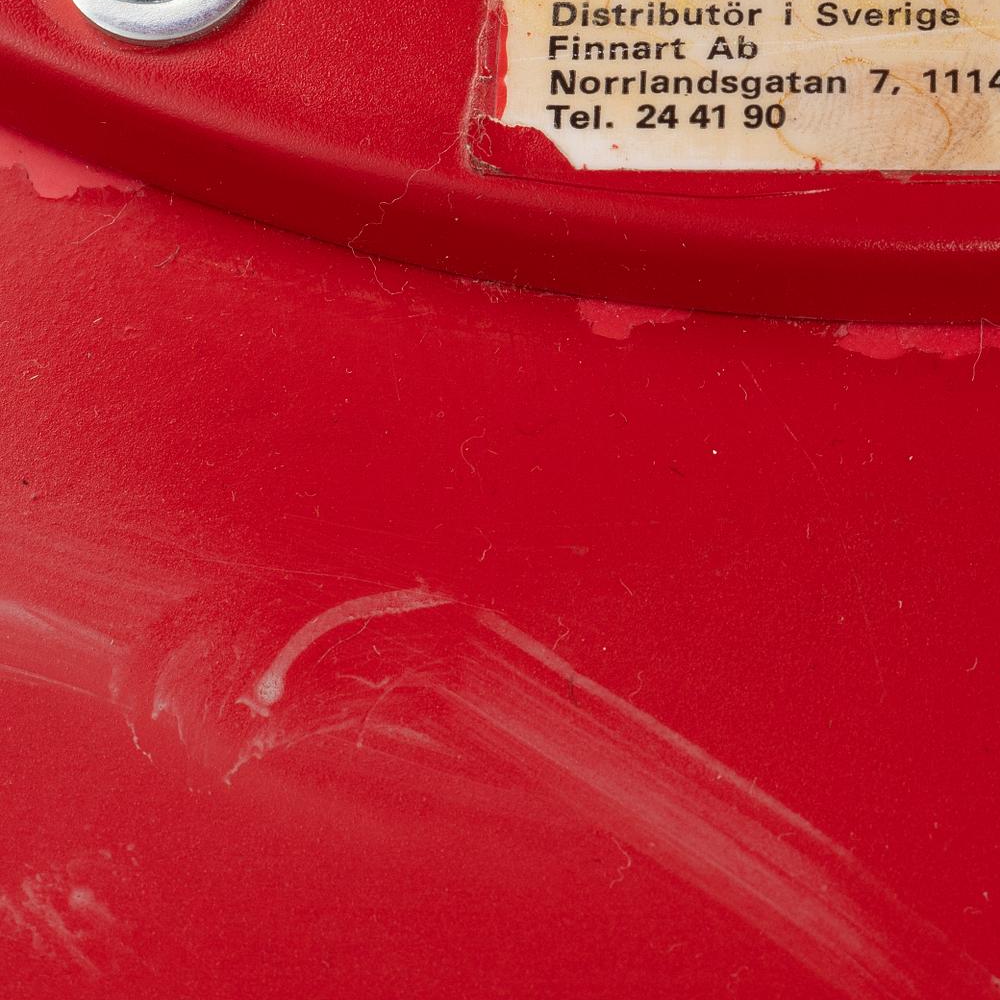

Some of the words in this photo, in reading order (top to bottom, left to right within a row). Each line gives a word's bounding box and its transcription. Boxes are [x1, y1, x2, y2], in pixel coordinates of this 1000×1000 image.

[552, 1, 762, 27] Distributör
[784, 1, 792, 26] i
[816, 1, 960, 31] Sverige
[548, 35, 686, 60] Finnart
[707, 35, 758, 60] Ab
[550, 69, 847, 100] Norrlandsgatan
[870, 69, 900, 96] 7,
[546, 104, 614, 130] Tel.
[636, 104, 679, 129] 24
[689, 104, 725, 129] 41
[743, 103, 786, 129] 90
